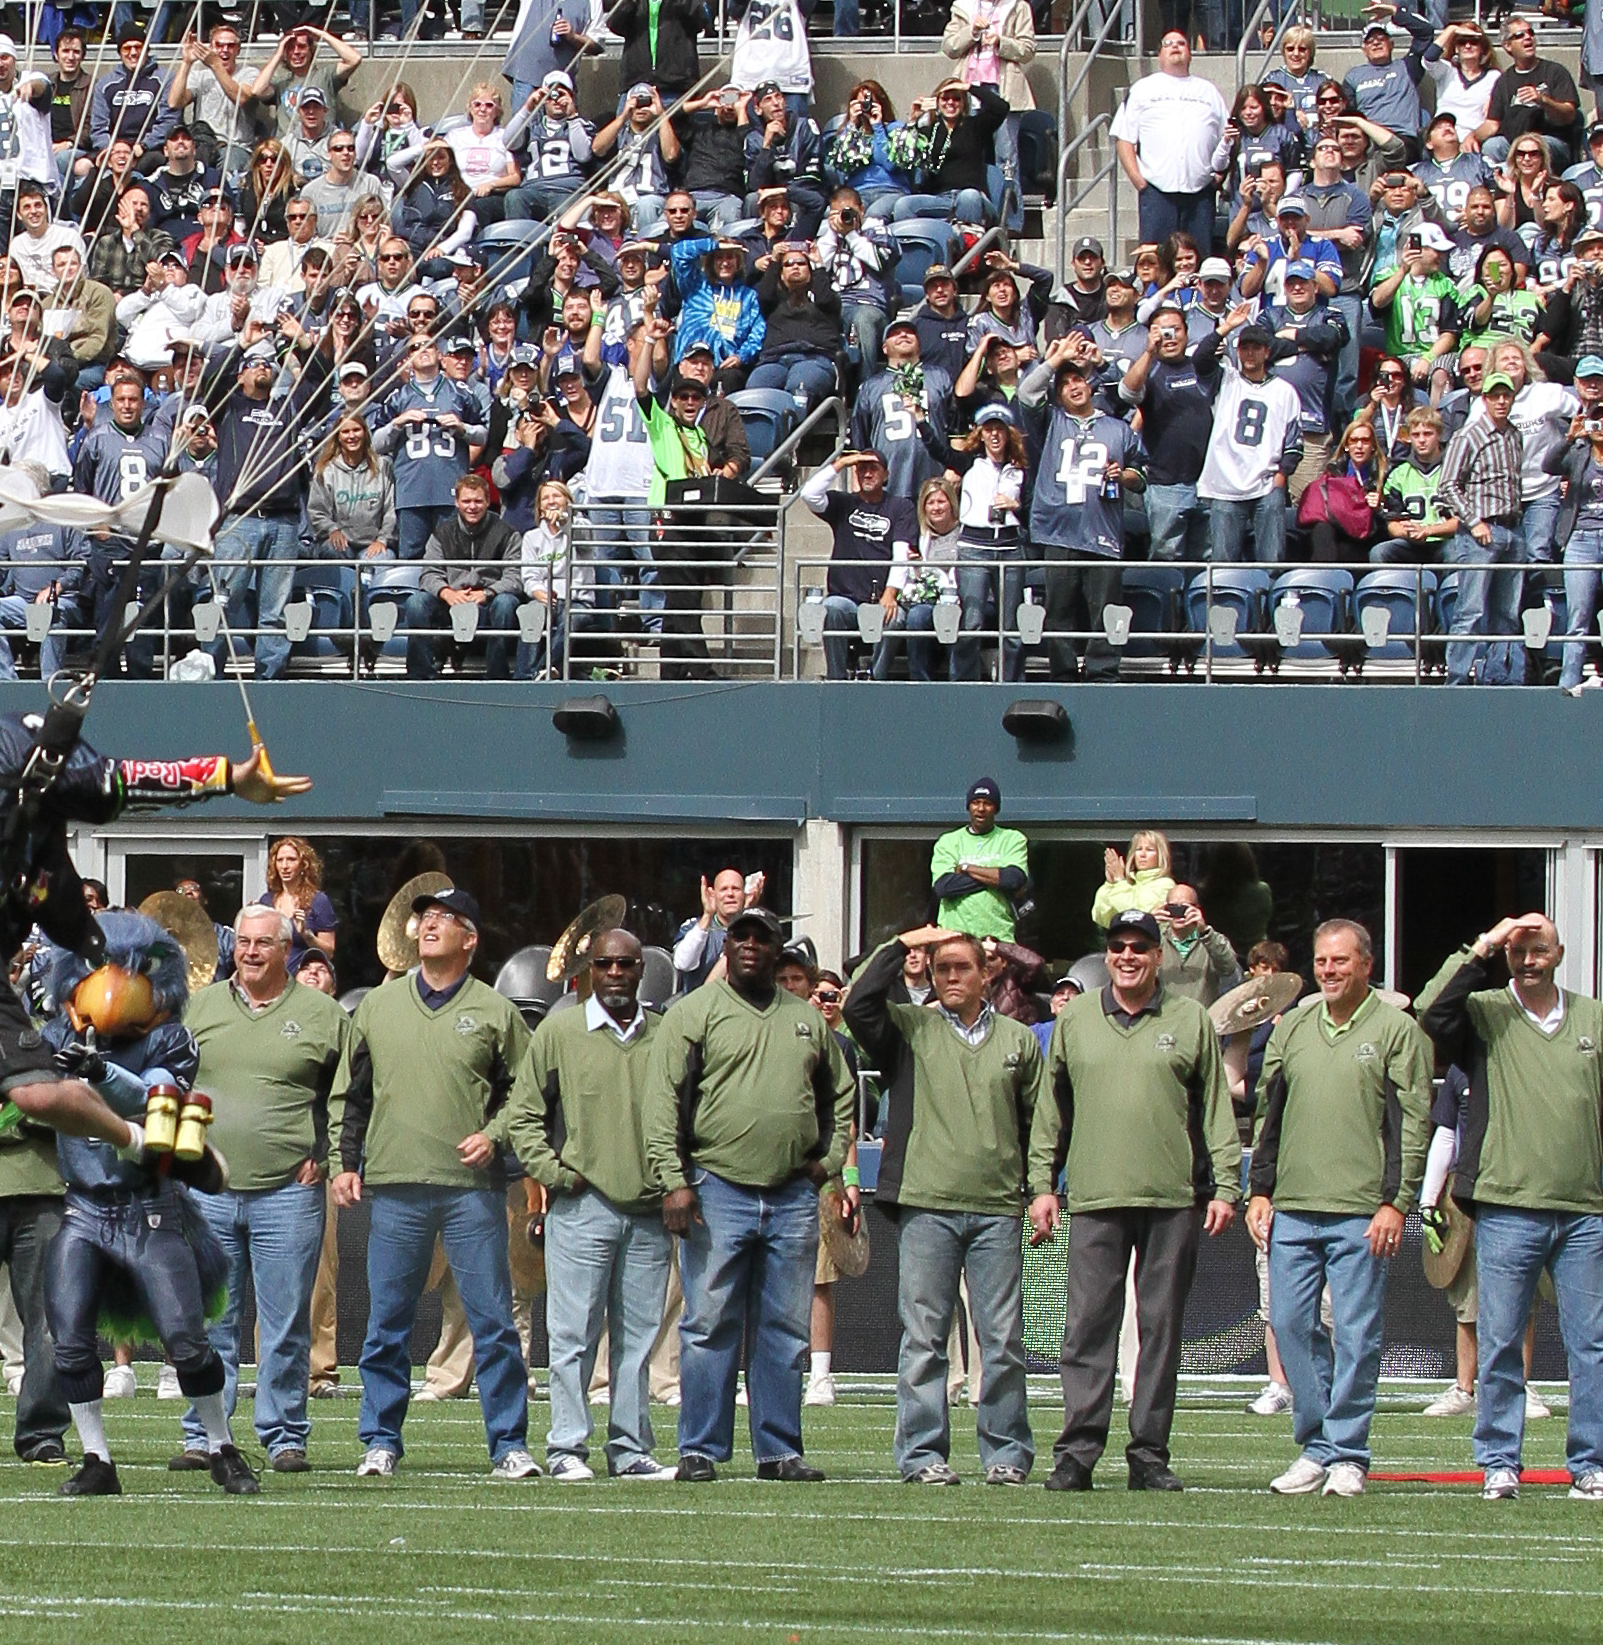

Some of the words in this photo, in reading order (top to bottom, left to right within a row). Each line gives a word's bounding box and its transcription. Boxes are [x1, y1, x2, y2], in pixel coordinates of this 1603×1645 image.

[526, 139, 571, 182] 12
[600, 397, 648, 443] 51
[1234, 398, 1269, 447] 8
[1055, 435, 1108, 484] 12
